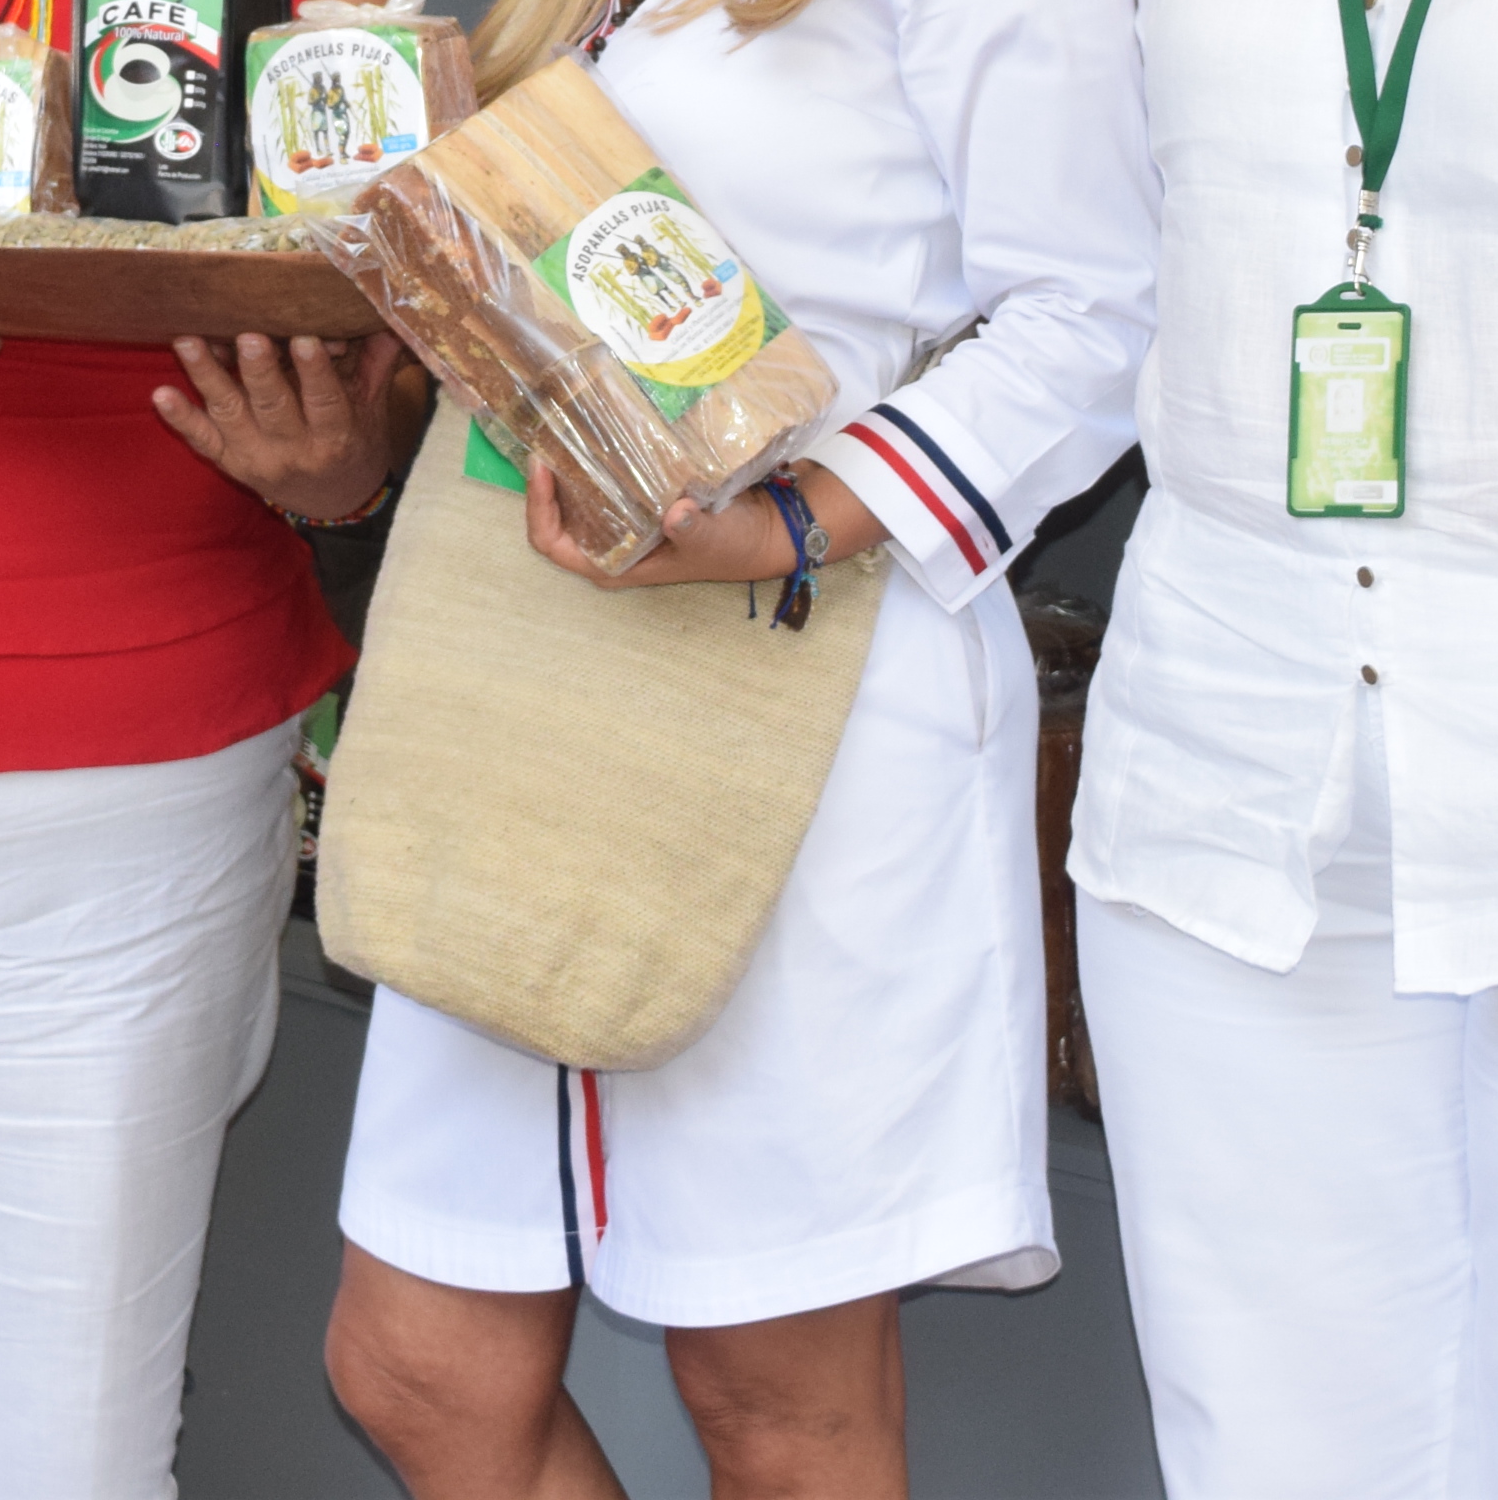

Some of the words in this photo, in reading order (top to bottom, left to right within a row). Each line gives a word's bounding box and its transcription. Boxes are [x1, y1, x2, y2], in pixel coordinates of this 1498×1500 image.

[114, 26, 142, 39] 100%
[144, 27, 185, 42] Natural
[266, 42, 345, 85] ASOPANELAS
[351, 42, 392, 66] PIJAS
[571, 210, 630, 282] ASOPANELAS
[630, 199, 671, 217] PIJAS
